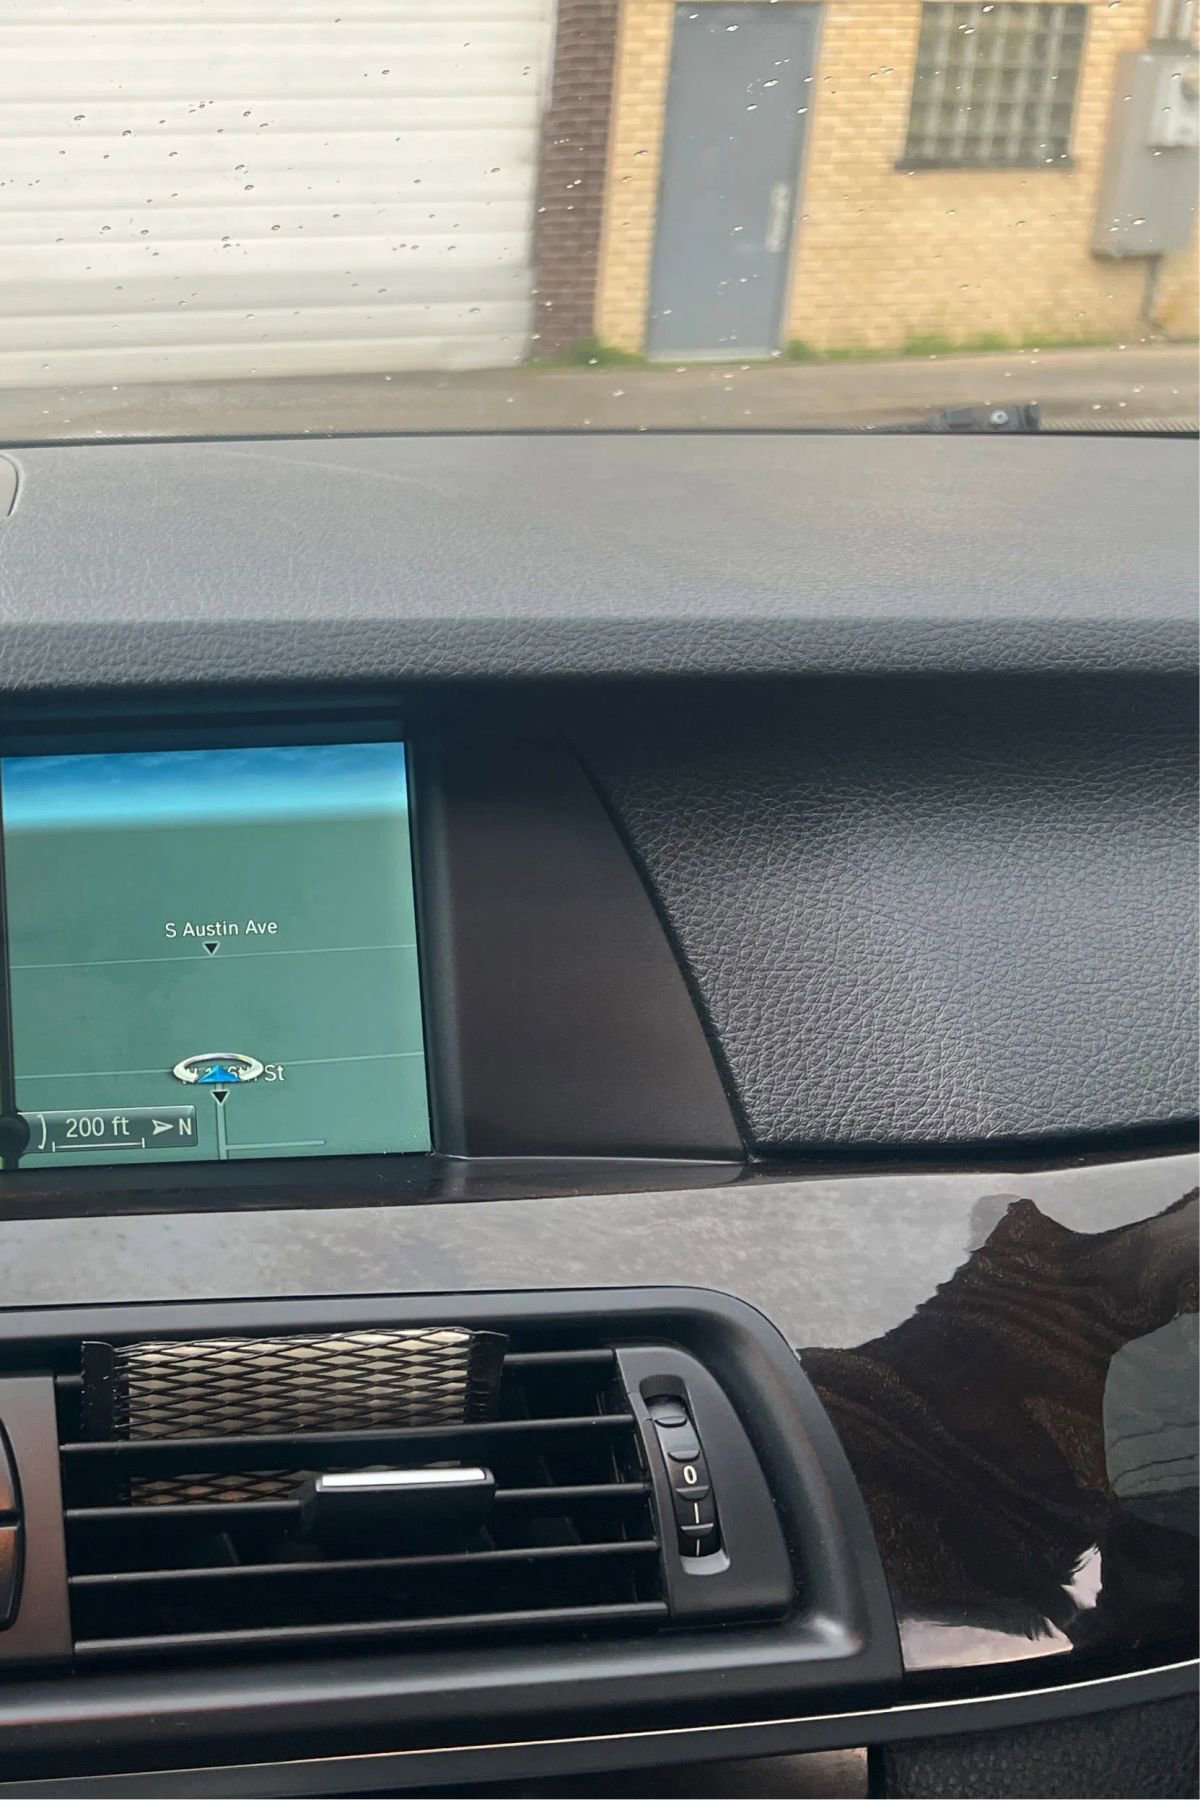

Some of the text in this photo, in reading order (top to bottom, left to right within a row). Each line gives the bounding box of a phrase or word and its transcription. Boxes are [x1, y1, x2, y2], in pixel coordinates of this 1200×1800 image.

[164, 919, 279, 938] S Austin Ave
[264, 1064, 286, 1082] St
[65, 1115, 131, 1138] 200 ft
[178, 1117, 193, 1136] N
